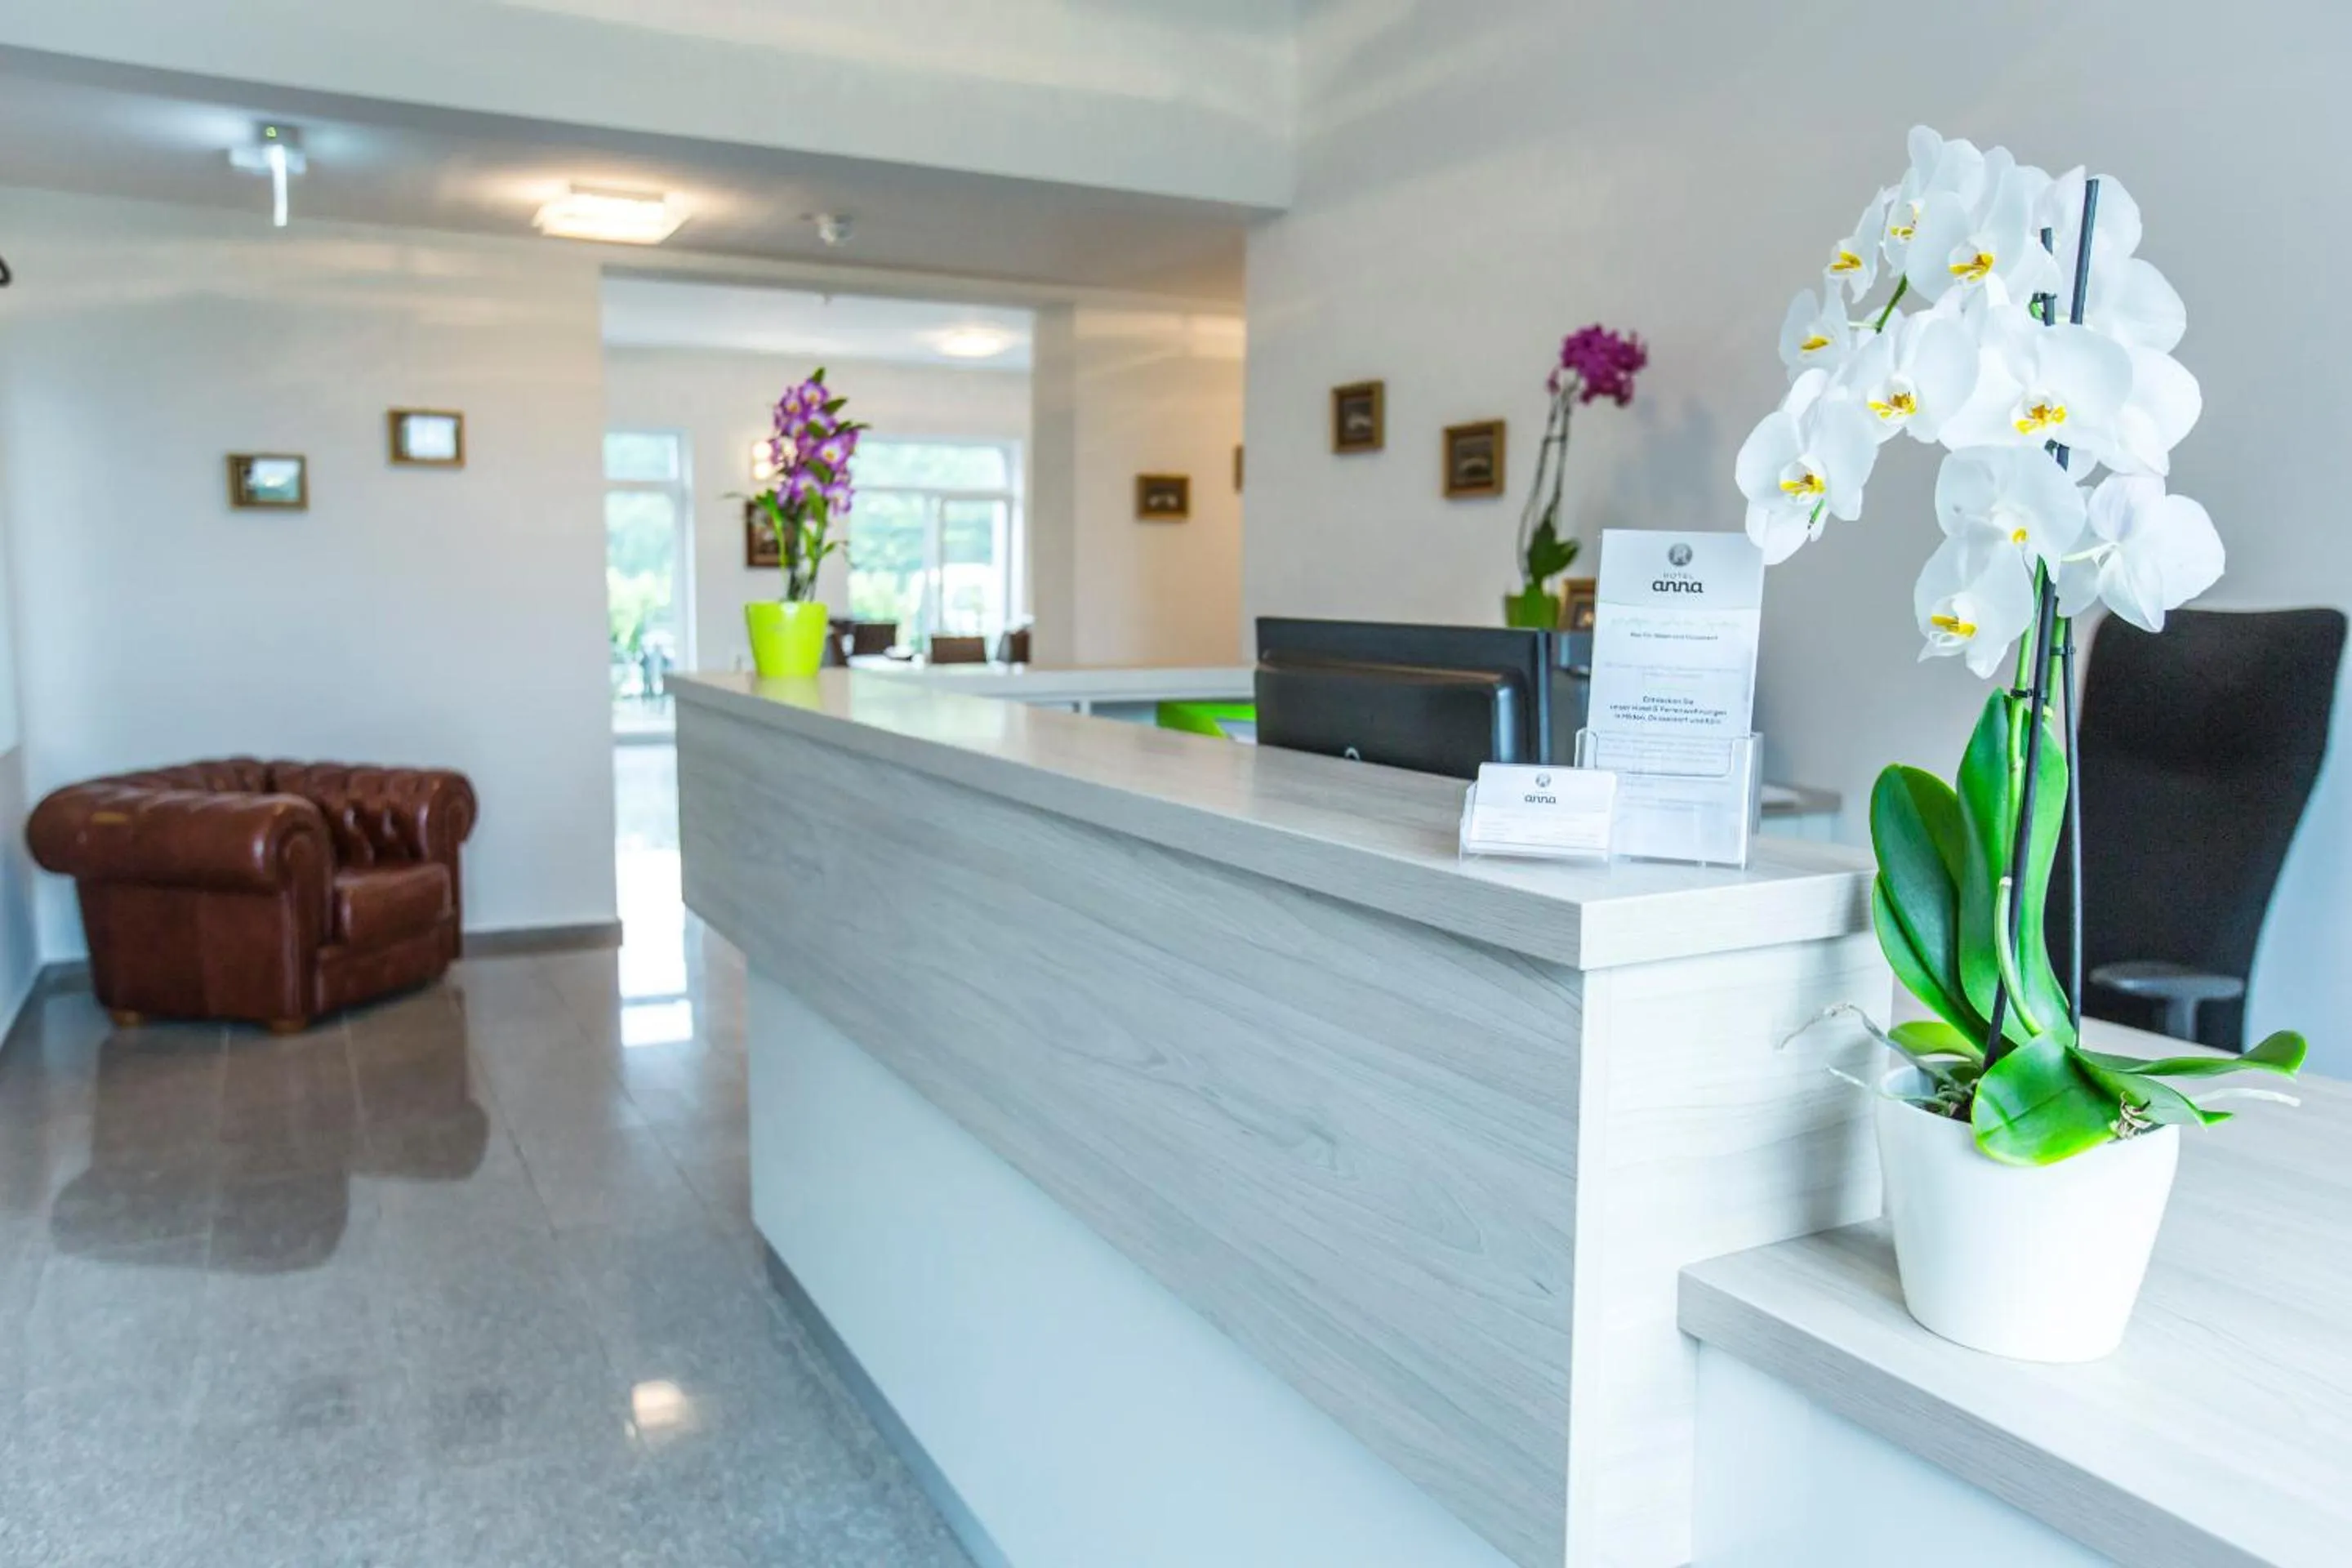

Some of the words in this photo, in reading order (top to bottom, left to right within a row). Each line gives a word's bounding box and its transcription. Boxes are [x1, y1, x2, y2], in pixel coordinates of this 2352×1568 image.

[1664, 572, 1694, 580] HOTEL
[1652, 580, 1704, 594] anna
[1524, 794, 1557, 804] anna
